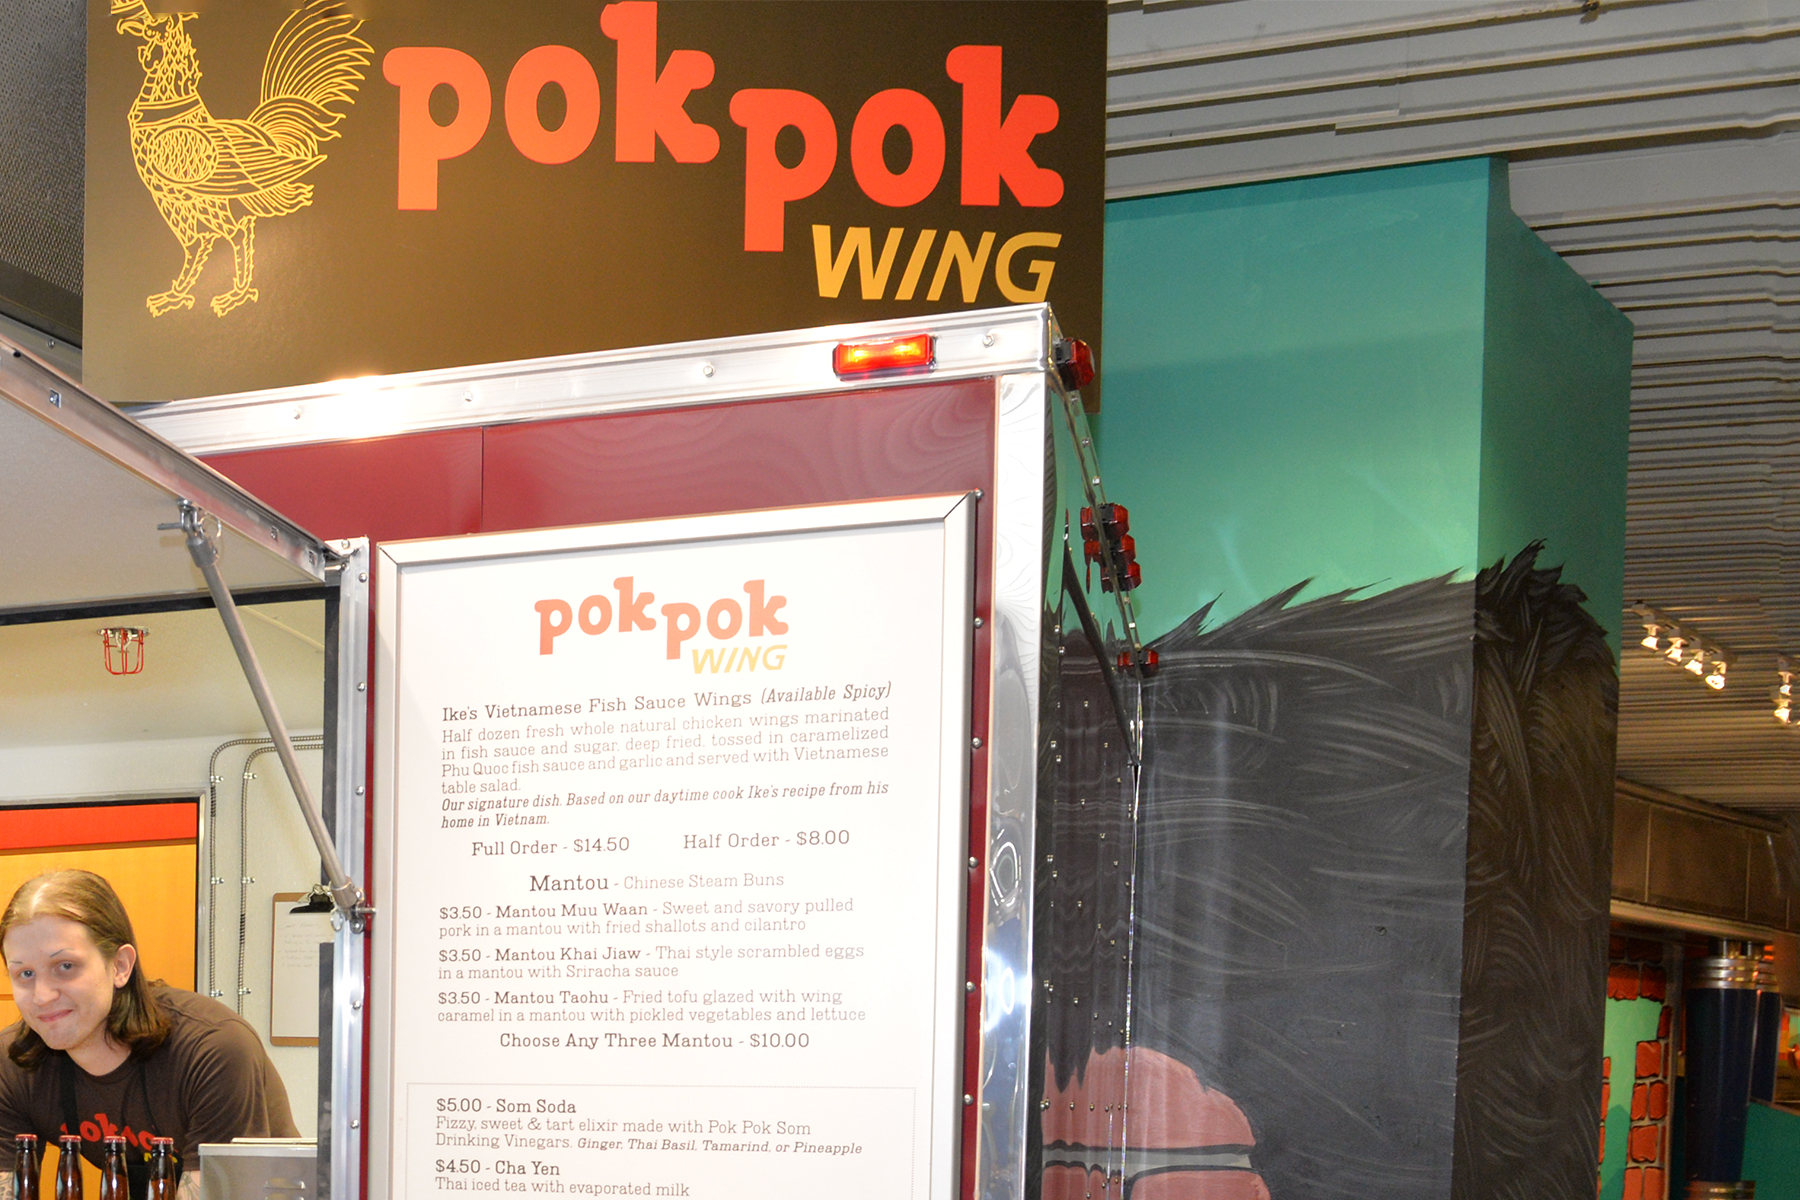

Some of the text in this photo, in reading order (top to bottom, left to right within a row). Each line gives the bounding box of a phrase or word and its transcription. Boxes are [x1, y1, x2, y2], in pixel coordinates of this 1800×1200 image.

[812, 225, 1062, 304] WING
[691, 644, 789, 675] WING
[442, 680, 892, 722] Ike's Vietnamese Fish Sauce Wings (Available Spicy)
[441, 780, 889, 812] Our signature dish. Based on our daytime cook Ike's recipe from his
[440, 812, 550, 829] home in Vietnam.
[471, 835, 630, 857] Full Order $14.50
[682, 828, 850, 849] Half Order $8.00
[528, 872, 784, 892] Mantou Chinese Steam Buns
[439, 897, 853, 920] $3.50 Mantou Muu Waan Sweet and savory pulled
[437, 943, 864, 963] $3.50 Mantou Khai Jiaw Thai style scrambled eggs
[437, 988, 843, 1005] $3.50 Mantou Taohu Fried tofu glazed with wing
[499, 1032, 810, 1049] Choose Any Three Mantou $10.00
[435, 1096, 577, 1114] $5.00 Som Soda
[434, 1157, 561, 1176] $4.50 Cha Yen
[434, 1175, 690, 1197] Thai iced tea with evaporated milk
